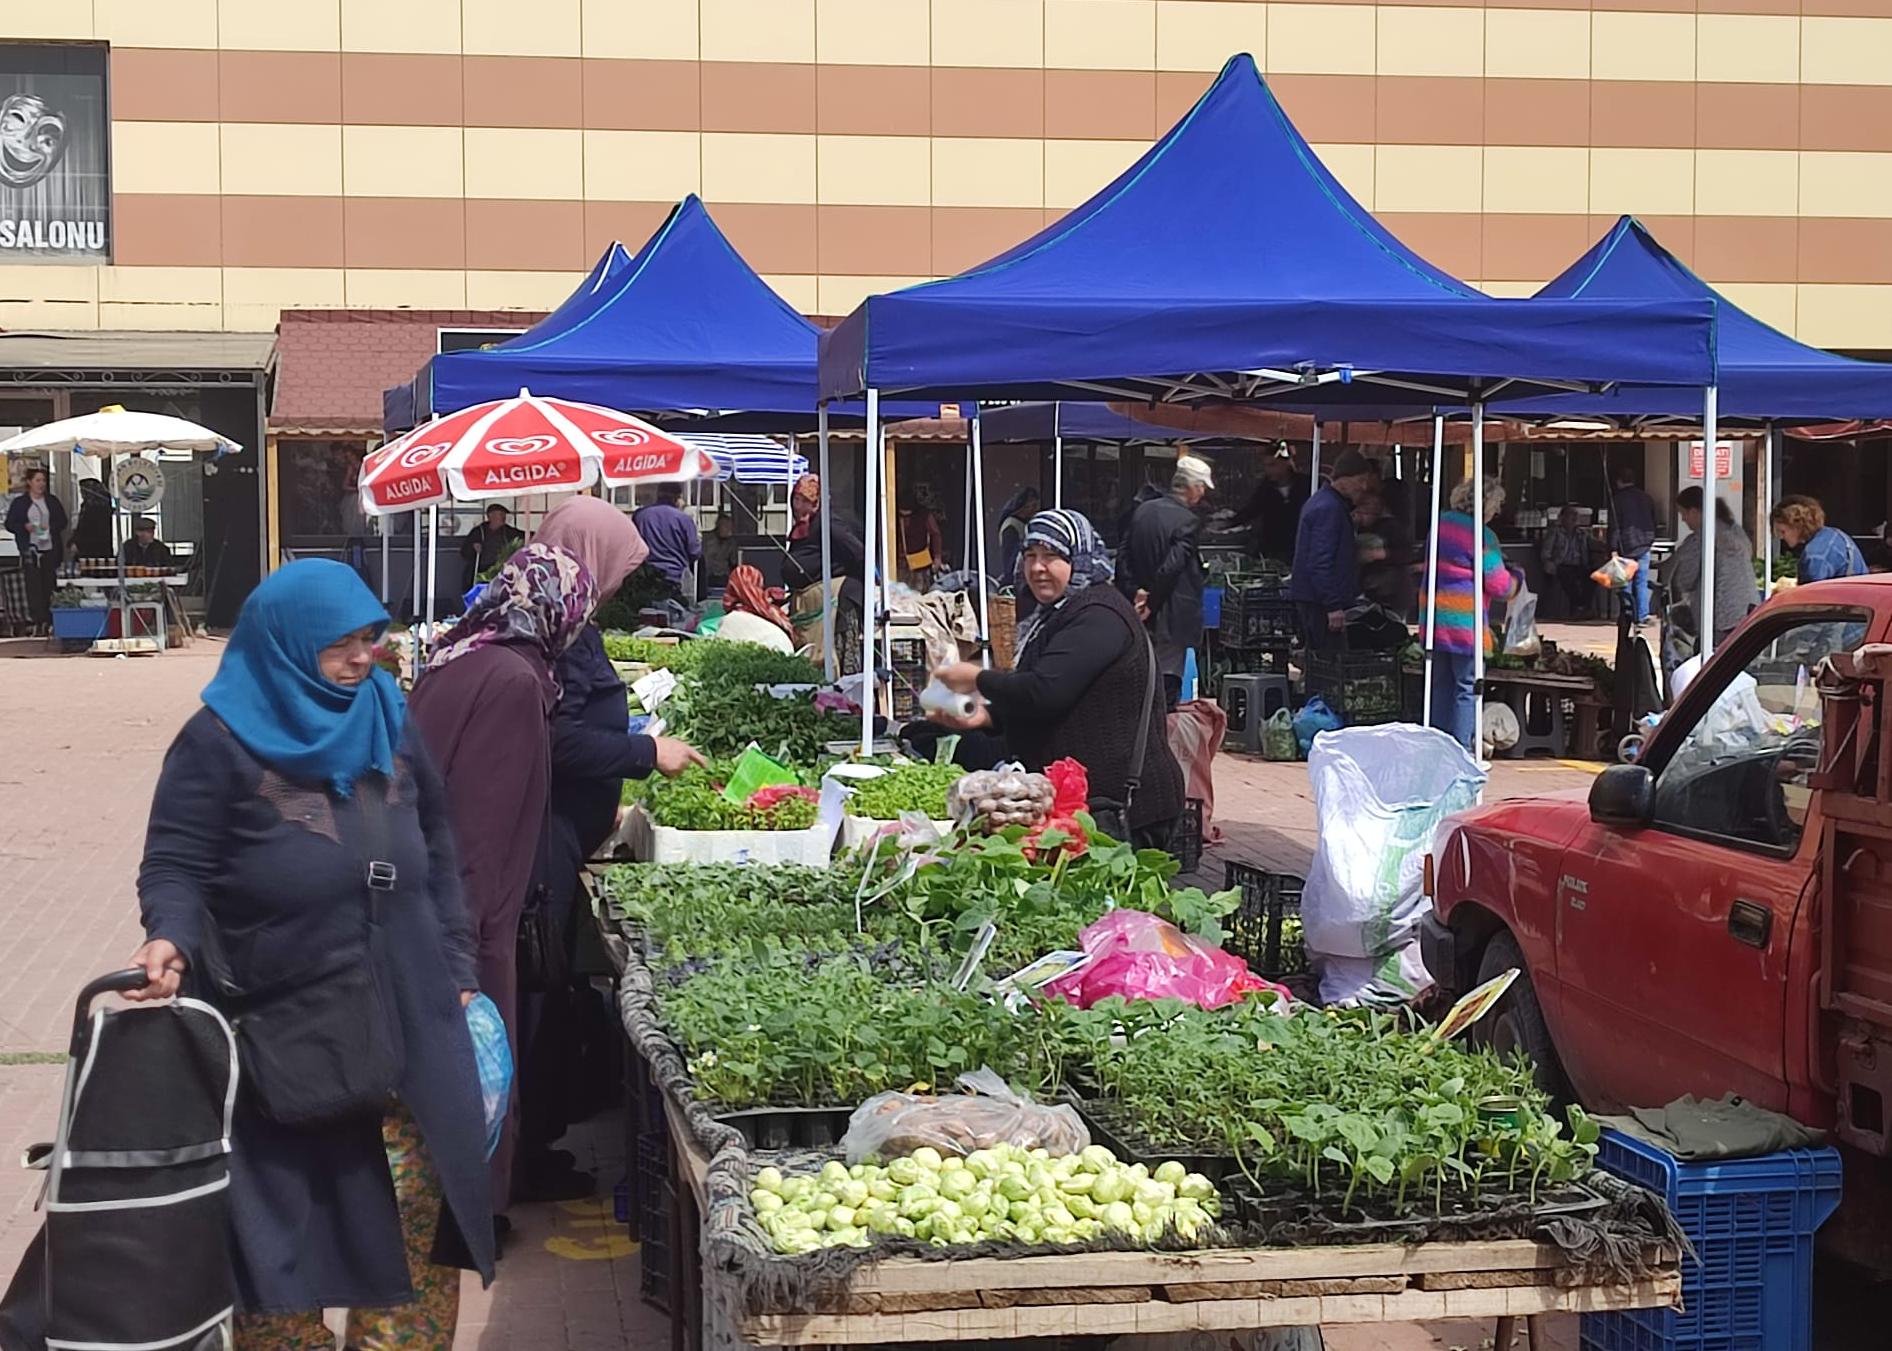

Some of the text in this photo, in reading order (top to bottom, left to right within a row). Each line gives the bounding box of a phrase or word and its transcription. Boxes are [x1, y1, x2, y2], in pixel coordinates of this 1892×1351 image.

[0, 219, 105, 250] SALONU
[485, 463, 561, 485] ALGIDA
[613, 454, 667, 473] ALGIDA
[386, 475, 432, 500] ALGIDA
